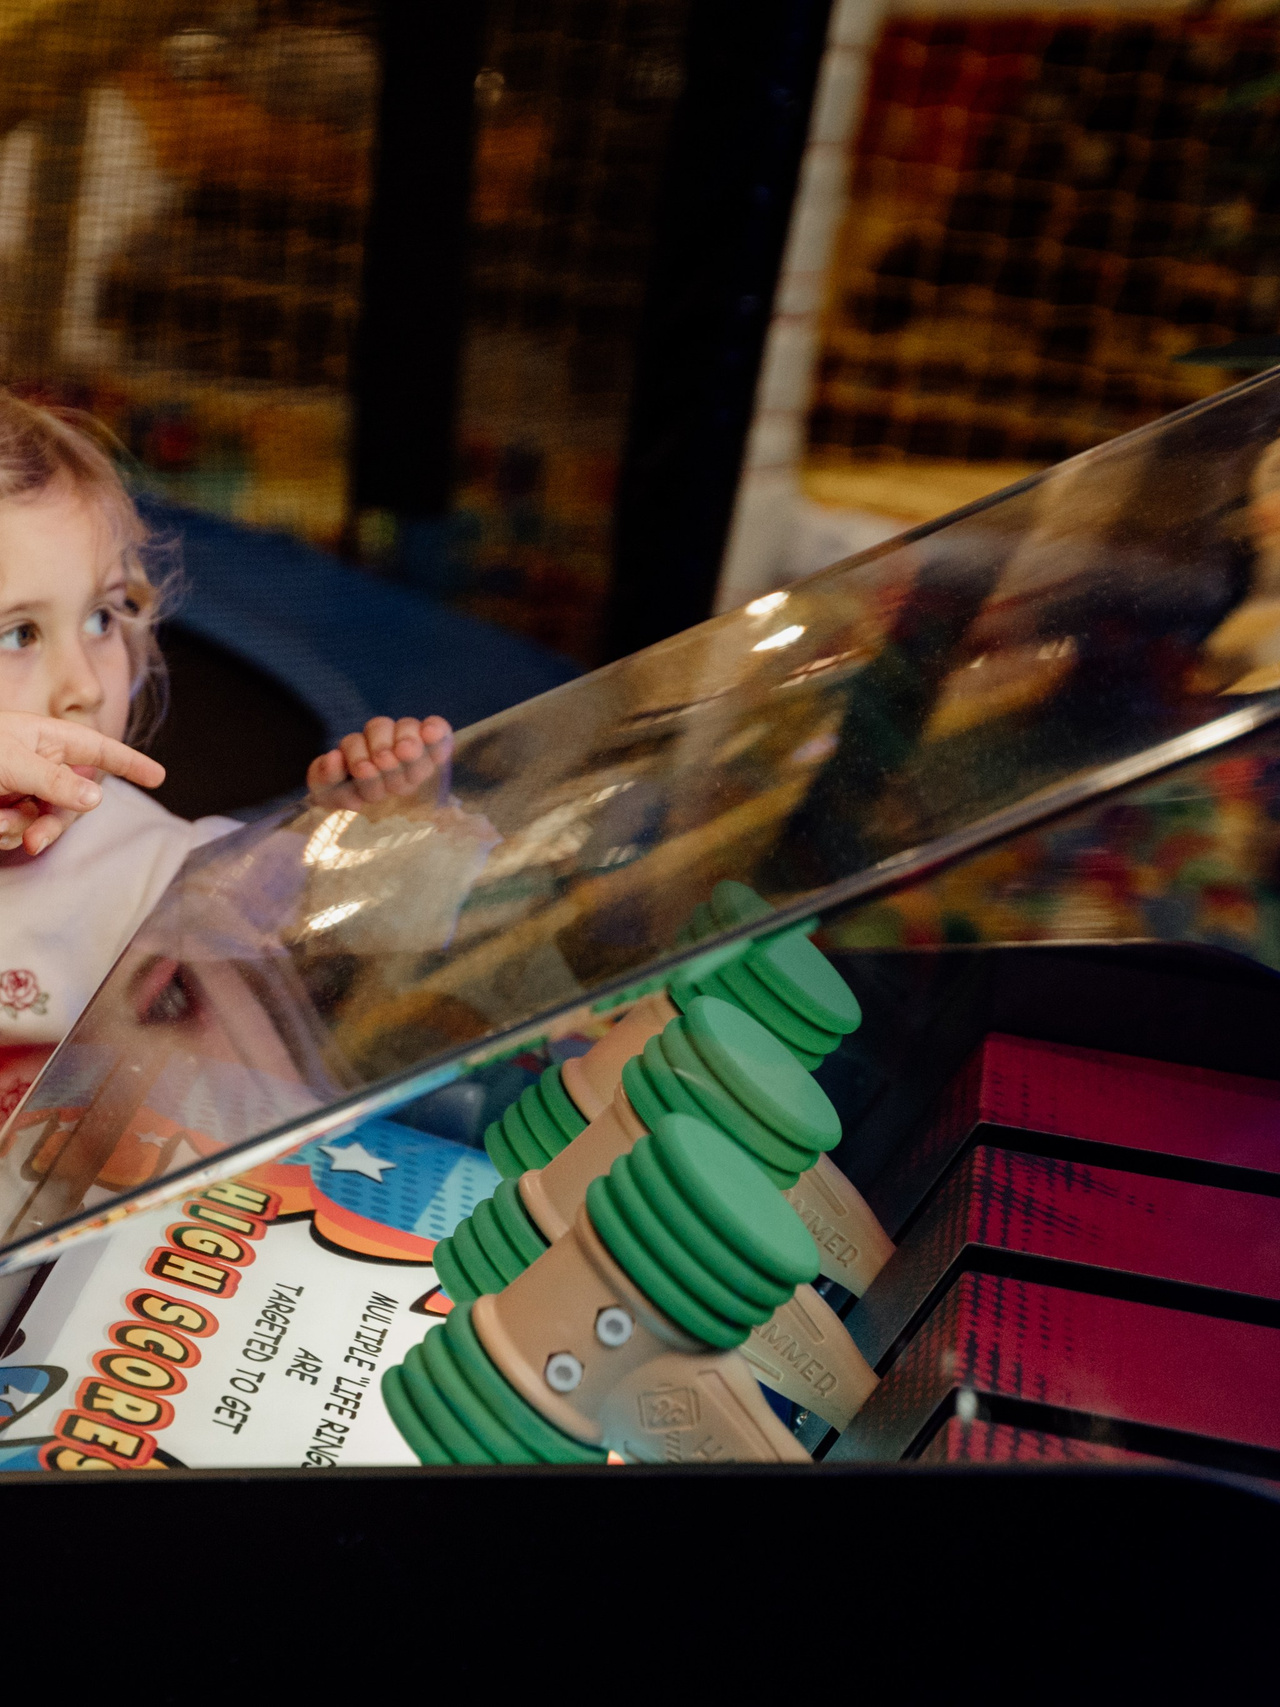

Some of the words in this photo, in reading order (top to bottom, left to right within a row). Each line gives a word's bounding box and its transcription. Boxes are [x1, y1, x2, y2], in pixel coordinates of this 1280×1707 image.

[150, 1181, 273, 1295] HIGH
[241, 1282, 305, 1363] TARGETED
[343, 1290, 399, 1372] MULTIPLE
[229, 1368, 267, 1394] TO
[285, 1347, 324, 1386] ARE
[212, 1395, 252, 1435] GET
[323, 1376, 371, 1420] "LIFE
[300, 1418, 350, 1468] RING
